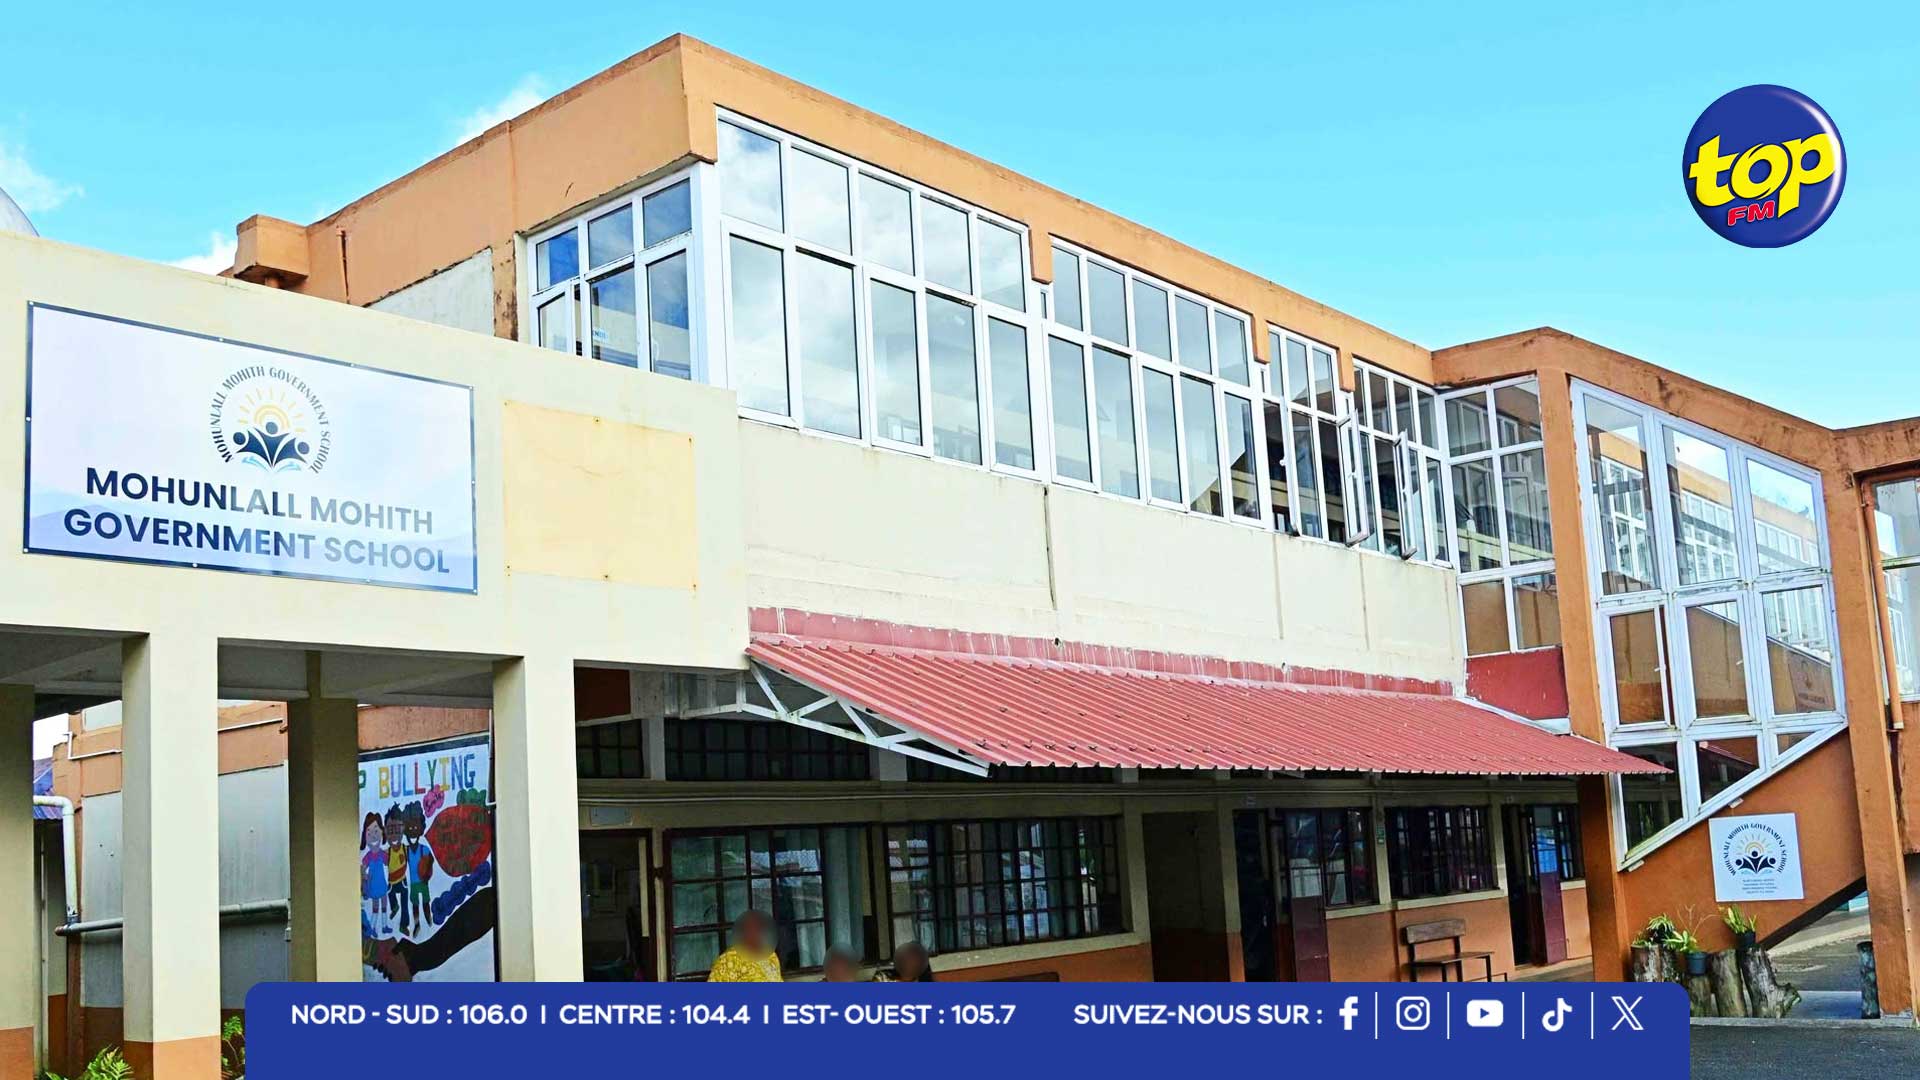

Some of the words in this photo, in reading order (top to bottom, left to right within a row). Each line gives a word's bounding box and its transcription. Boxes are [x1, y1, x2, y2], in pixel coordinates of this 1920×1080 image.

[210, 391, 233, 464] MOHUNLALL
[222, 366, 266, 390] MOHITH
[269, 367, 329, 425] GOVERNMENT
[308, 429, 332, 474] SCHOOL
[86, 467, 303, 520] MOHUNLALL
[310, 496, 433, 535] MOHITH
[63, 508, 316, 560] GOVERNMENT
[324, 538, 450, 574] SCHOOL
[378, 753, 476, 800] BULLYING
